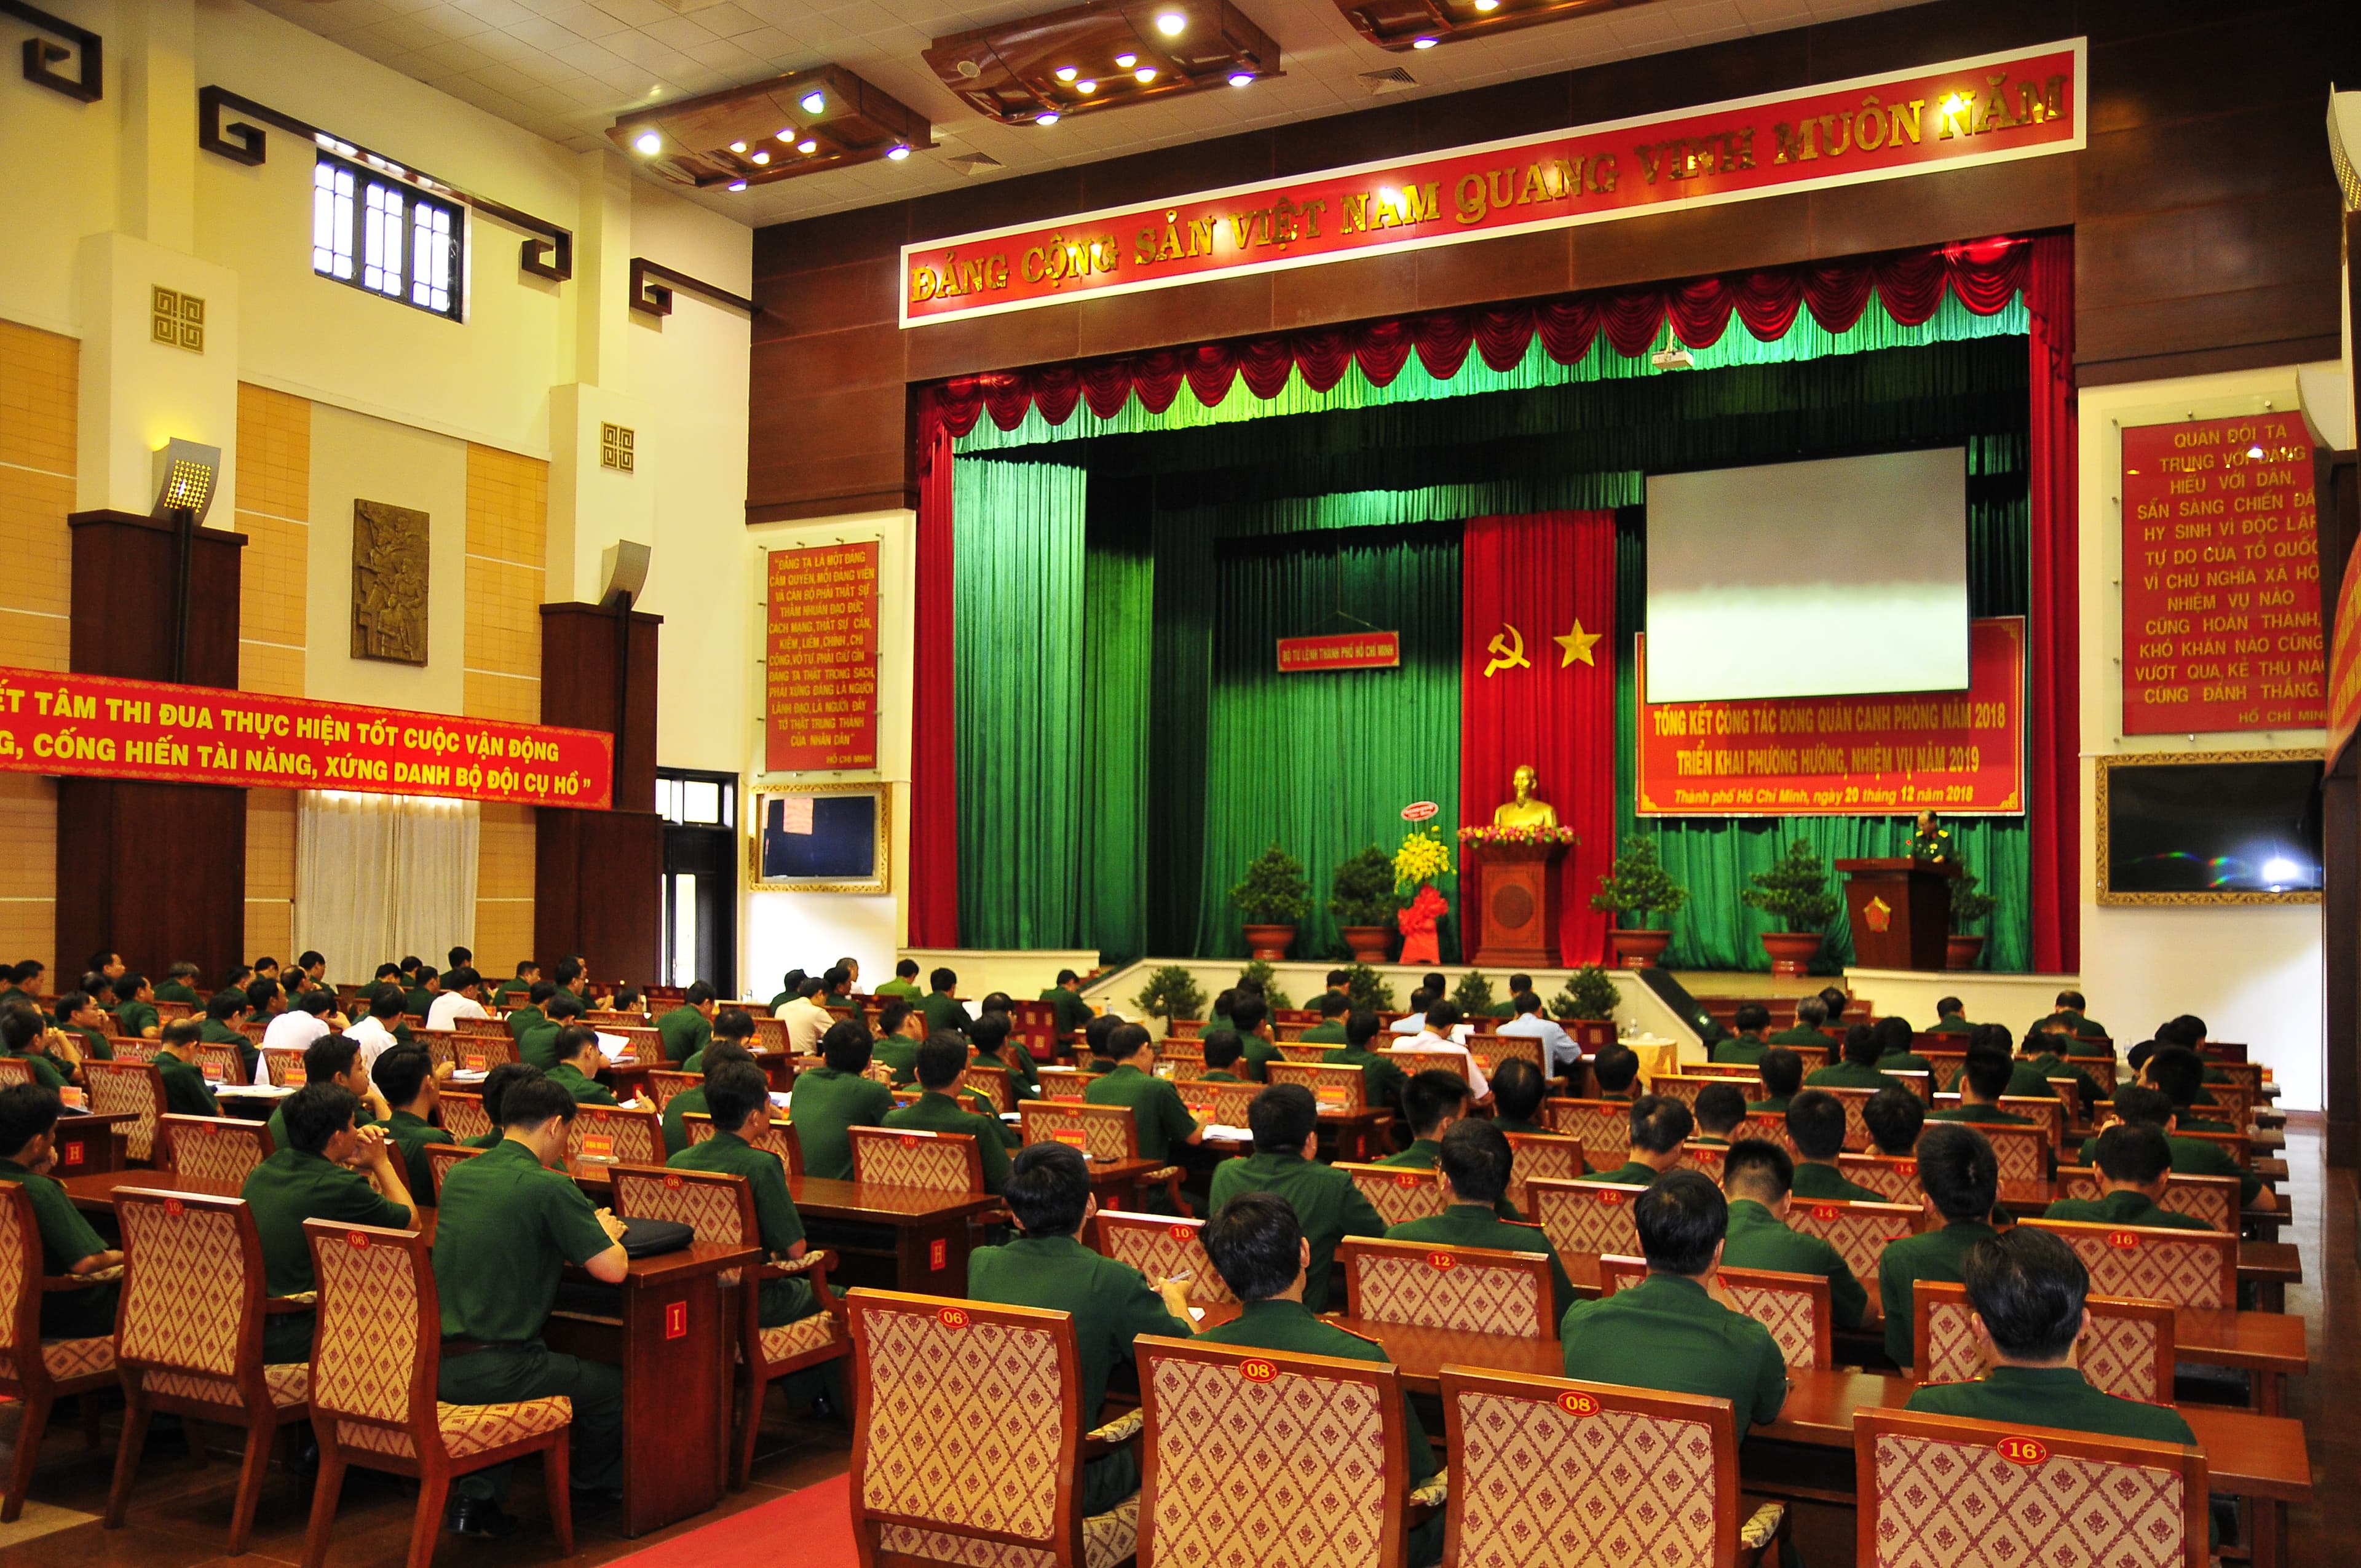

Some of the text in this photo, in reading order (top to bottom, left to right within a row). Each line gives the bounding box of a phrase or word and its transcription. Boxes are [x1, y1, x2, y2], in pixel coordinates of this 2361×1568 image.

[910, 71, 2068, 303] ĐẢNG CỘNG SẢN VIỆT NAM QUANG VINH MUÔN NĂM
[2174, 423, 2287, 449] QUÂN ĐỘI TA
[2159, 453, 2215, 472] TRUNG
[2170, 473, 2206, 495] HIẾU
[2219, 470, 2245, 490] VỚI
[2180, 498, 2224, 517] SÀNG
[2234, 489, 2284, 513] CHIẾN
[2144, 526, 2165, 542] HY
[2175, 523, 2212, 540] SINH
[2220, 517, 2234, 536] VÌ
[2242, 515, 2278, 537] ĐỘC
[2145, 548, 2167, 569] TỰ
[2174, 548, 2197, 565] DO
[2204, 542, 2237, 563] CỦA
[2245, 535, 2267, 560] TỔ
[2167, 568, 2199, 589] CHỦ
[2207, 566, 2256, 586] NGHĨA
[2265, 563, 2288, 583] XÃ
[2167, 587, 2295, 613] NHIỆM VỤ NÀO
[2145, 617, 2190, 636] CŨNG
[2203, 614, 2248, 632] HOÀN
[2140, 639, 2173, 659] KHÓ
[2181, 638, 2226, 657] KHĂN
[2235, 635, 2269, 654] NÀO
[2135, 664, 2178, 682] VƯỢT
[2228, 657, 2249, 678] KẺ
[2203, 681, 2247, 703] ĐÁNH
[1975, 702, 2006, 729] 2018
[2267, 709, 2291, 723] CHÍ
[34, 687, 96, 719] TÂM
[105, 698, 151, 724] THI
[159, 703, 213, 729] ĐUA
[221, 709, 289, 740] THỰC
[296, 713, 350, 745] HIỆN
[357, 718, 399, 746] TỐT
[403, 726, 460, 756] CUỘC
[465, 731, 504, 760] VẬN
[508, 735, 559, 764] ĐỘNG
[33, 726, 116, 762] CỐNG
[125, 734, 189, 766] HIẾN
[197, 741, 237, 770] TÀI
[245, 745, 318, 780] NĂNG,
[324, 752, 388, 781] XỨNG
[394, 761, 450, 786] DANH
[456, 763, 482, 793] BỘ
[487, 766, 520, 795] ĐỘI
[524, 773, 549, 798] CỤ
[1715, 750, 1744, 775] KHAI
[1949, 746, 1980, 773] 2019
[1845, 786, 1859, 803] 20
[1900, 785, 1915, 802] 12
[1946, 785, 1974, 802] 2018
[904, 1138, 915, 1146] 10
[70, 1147, 79, 1160] H
[1699, 1151, 1711, 1160] 12
[1898, 1165, 1911, 1173] 14
[667, 1178, 679, 1187] 08
[1401, 1175, 1414, 1185] 12
[170, 1202, 179, 1211] 10
[1604, 1192, 1616, 1202] 12
[1819, 1208, 1833, 1218] 14
[352, 1234, 365, 1245] 06
[1176, 1228, 1189, 1238] 10
[2116, 1234, 2132, 1245] 16
[934, 1245, 943, 1265] H
[1434, 1254, 1450, 1267] 12
[943, 1311, 963, 1324] 06
[1246, 1363, 1270, 1377] 08
[1565, 1395, 1591, 1411] 08
[2009, 1441, 2037, 1460] 16
